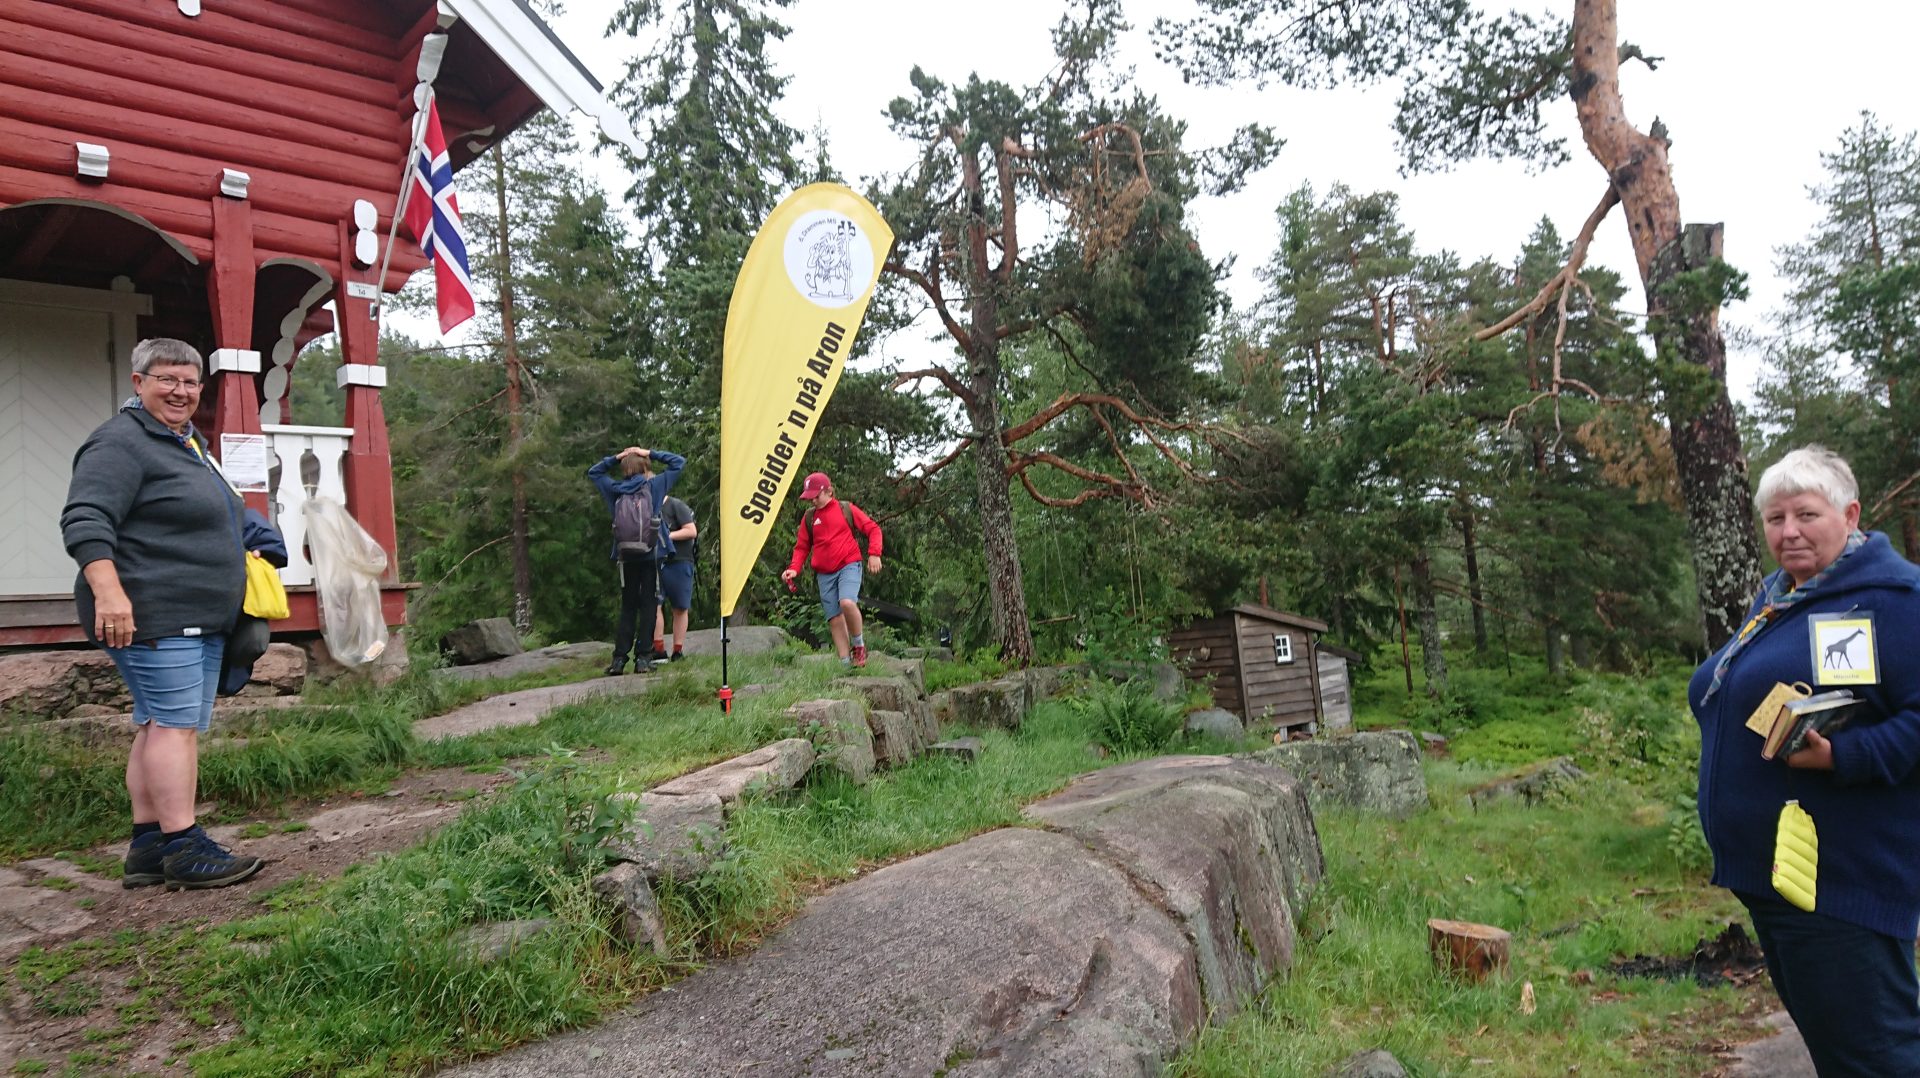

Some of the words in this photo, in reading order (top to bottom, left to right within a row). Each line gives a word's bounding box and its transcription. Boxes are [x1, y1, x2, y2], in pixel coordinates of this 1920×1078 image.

[358, 288, 366, 296] 14
[806, 321, 846, 379] Aron
[796, 376, 823, 412] på
